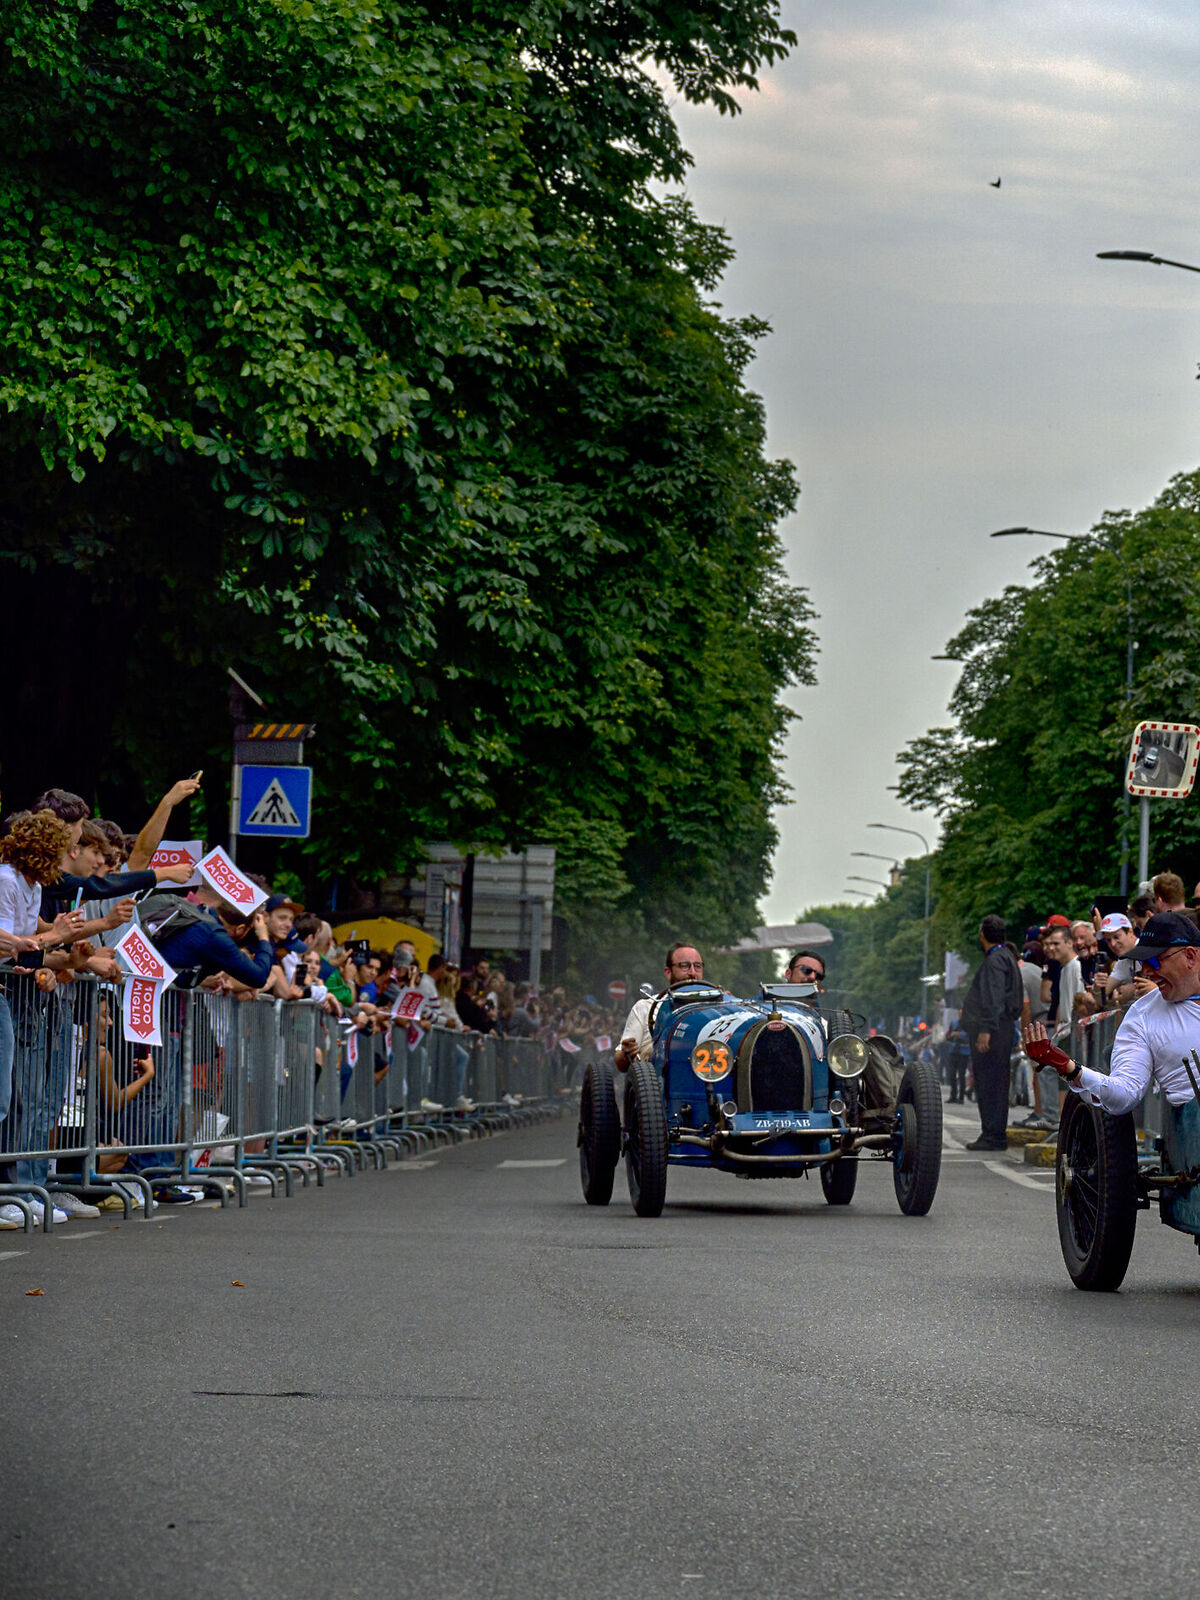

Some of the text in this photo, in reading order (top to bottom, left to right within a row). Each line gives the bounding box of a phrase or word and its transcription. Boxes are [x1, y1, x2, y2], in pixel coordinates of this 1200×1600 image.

[207, 864, 240, 898] MIGLIA
[216, 860, 246, 890] 1000
[134, 938, 157, 969] 1000
[131, 981, 143, 1025] MIGLIA
[143, 986, 153, 1024] 1000
[695, 1049, 728, 1072] 23
